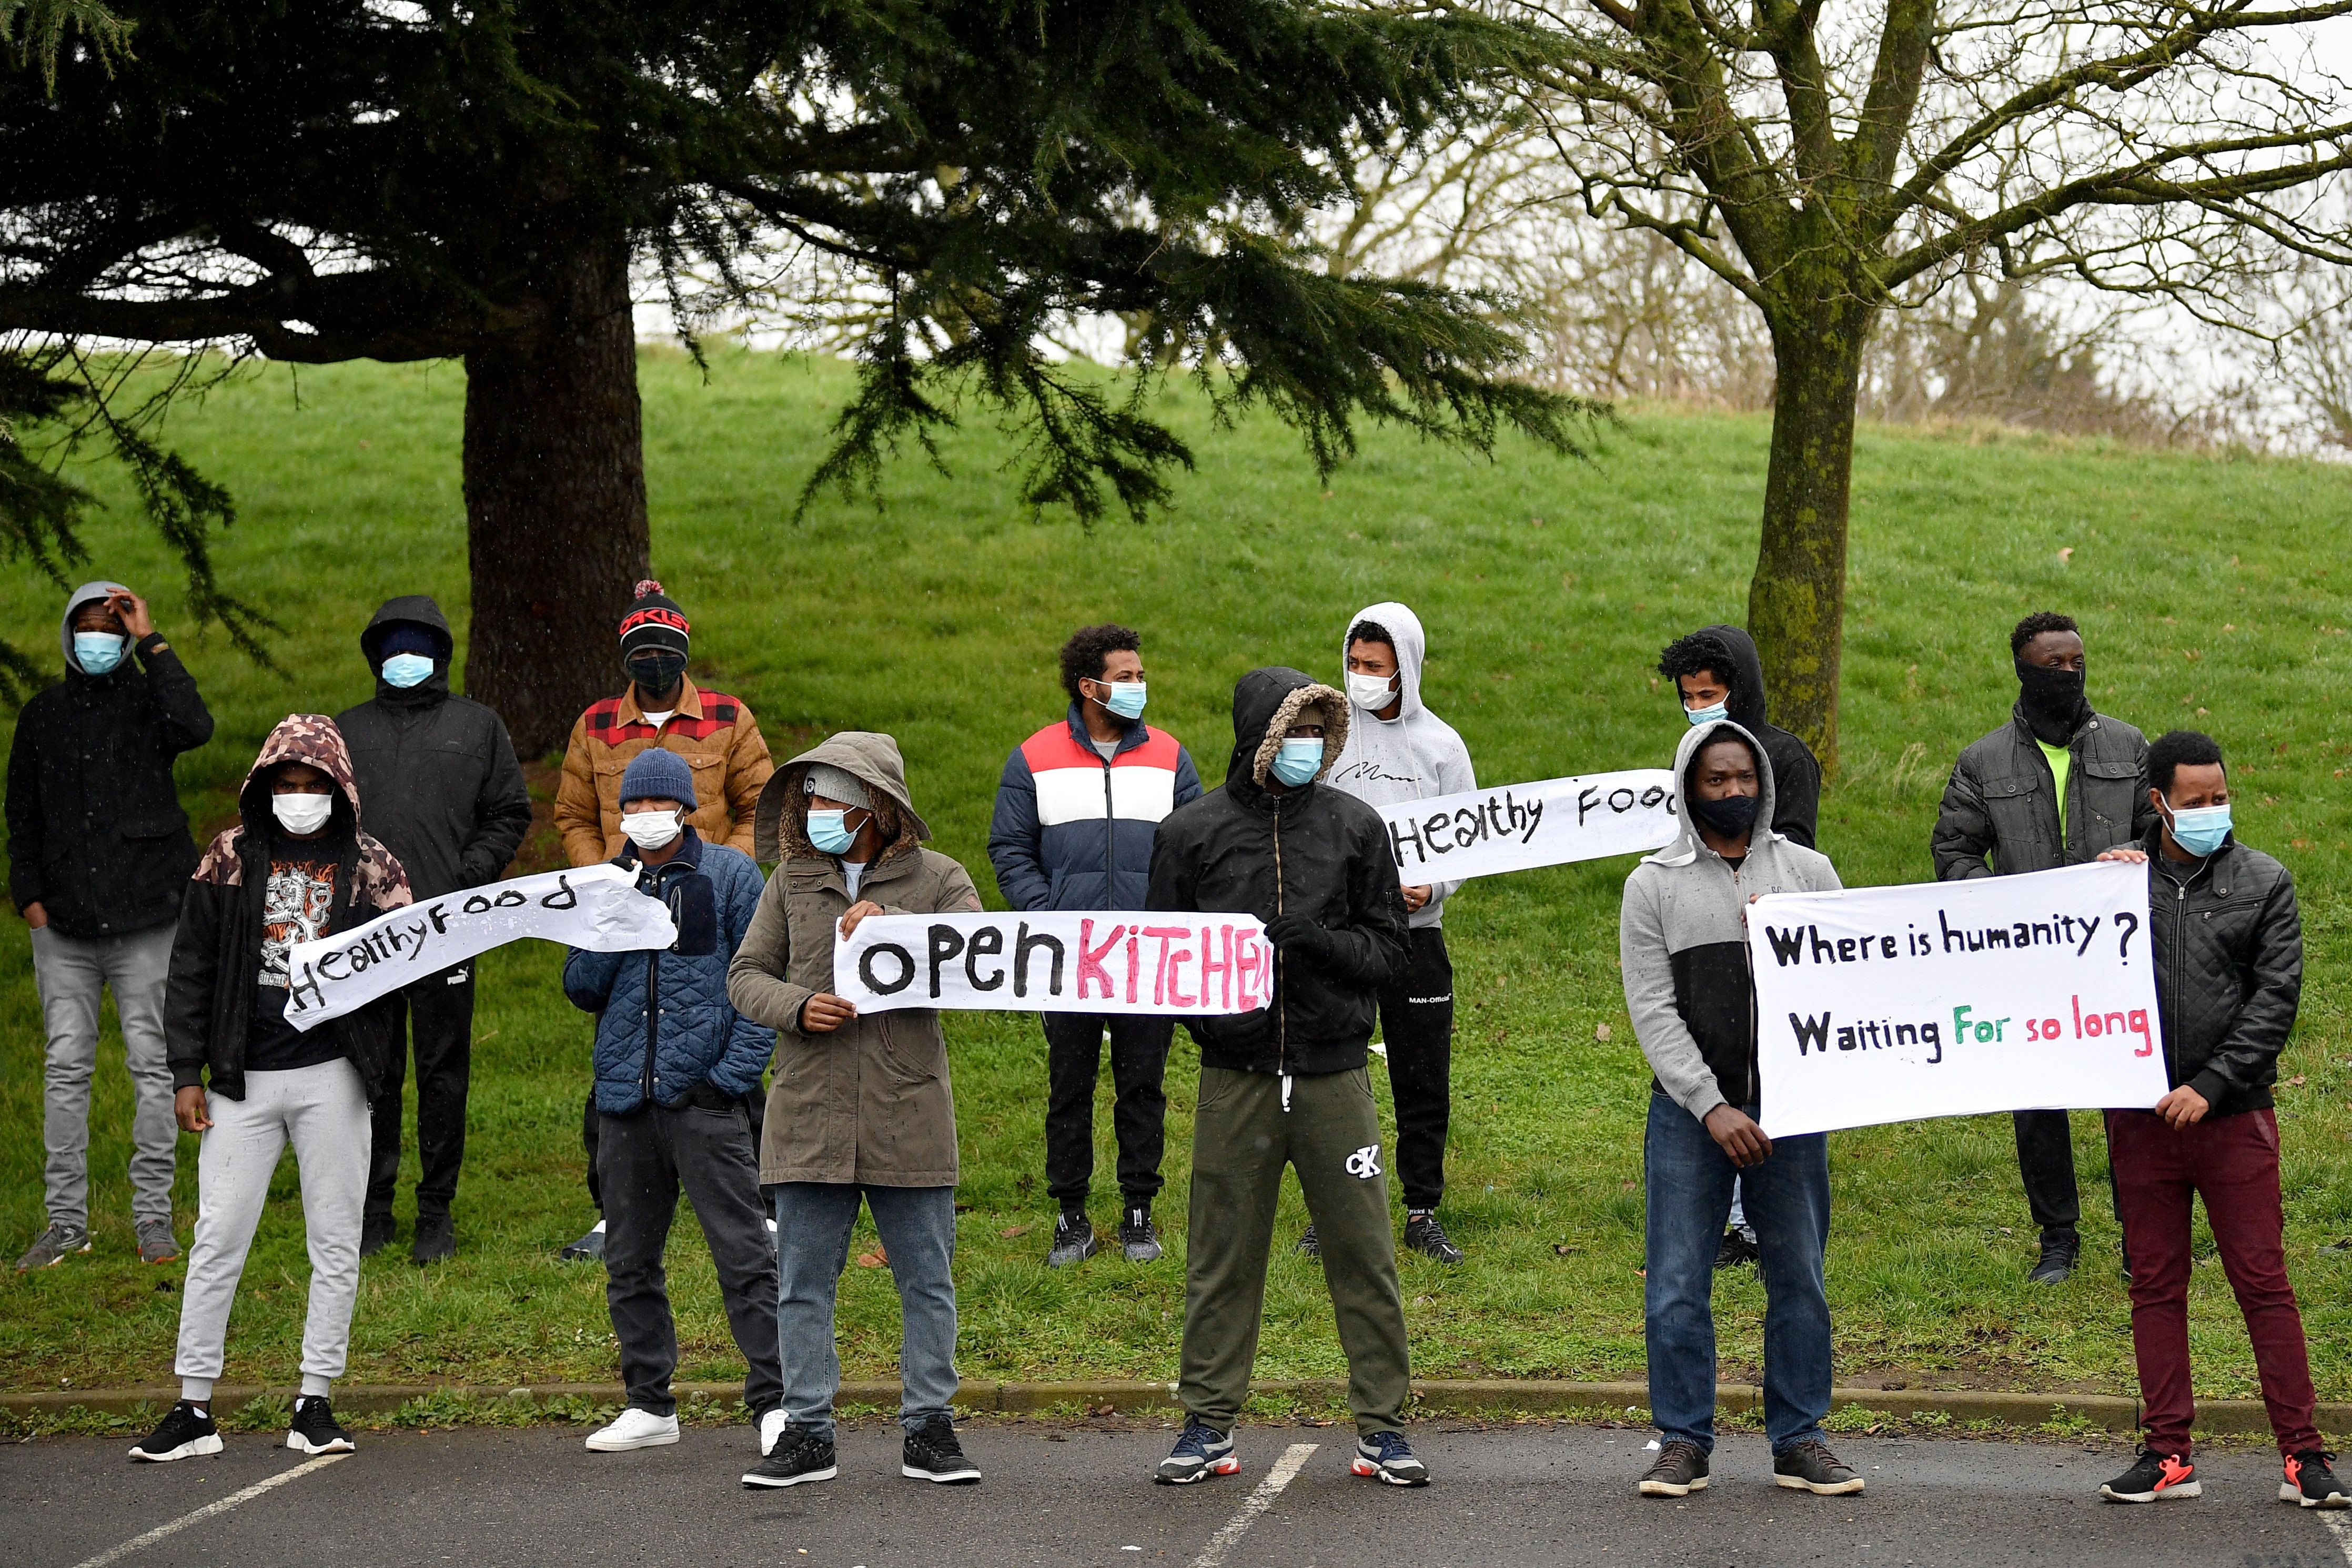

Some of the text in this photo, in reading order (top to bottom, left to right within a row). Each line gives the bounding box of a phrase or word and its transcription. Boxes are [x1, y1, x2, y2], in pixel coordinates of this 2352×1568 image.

[619, 610, 690, 634] OAKLEY
[1389, 791, 1543, 867] Healthy
[1765, 925, 1897, 967] Where
[1909, 924, 1931, 956] is
[1789, 995, 2153, 1064] Waiting For so long
